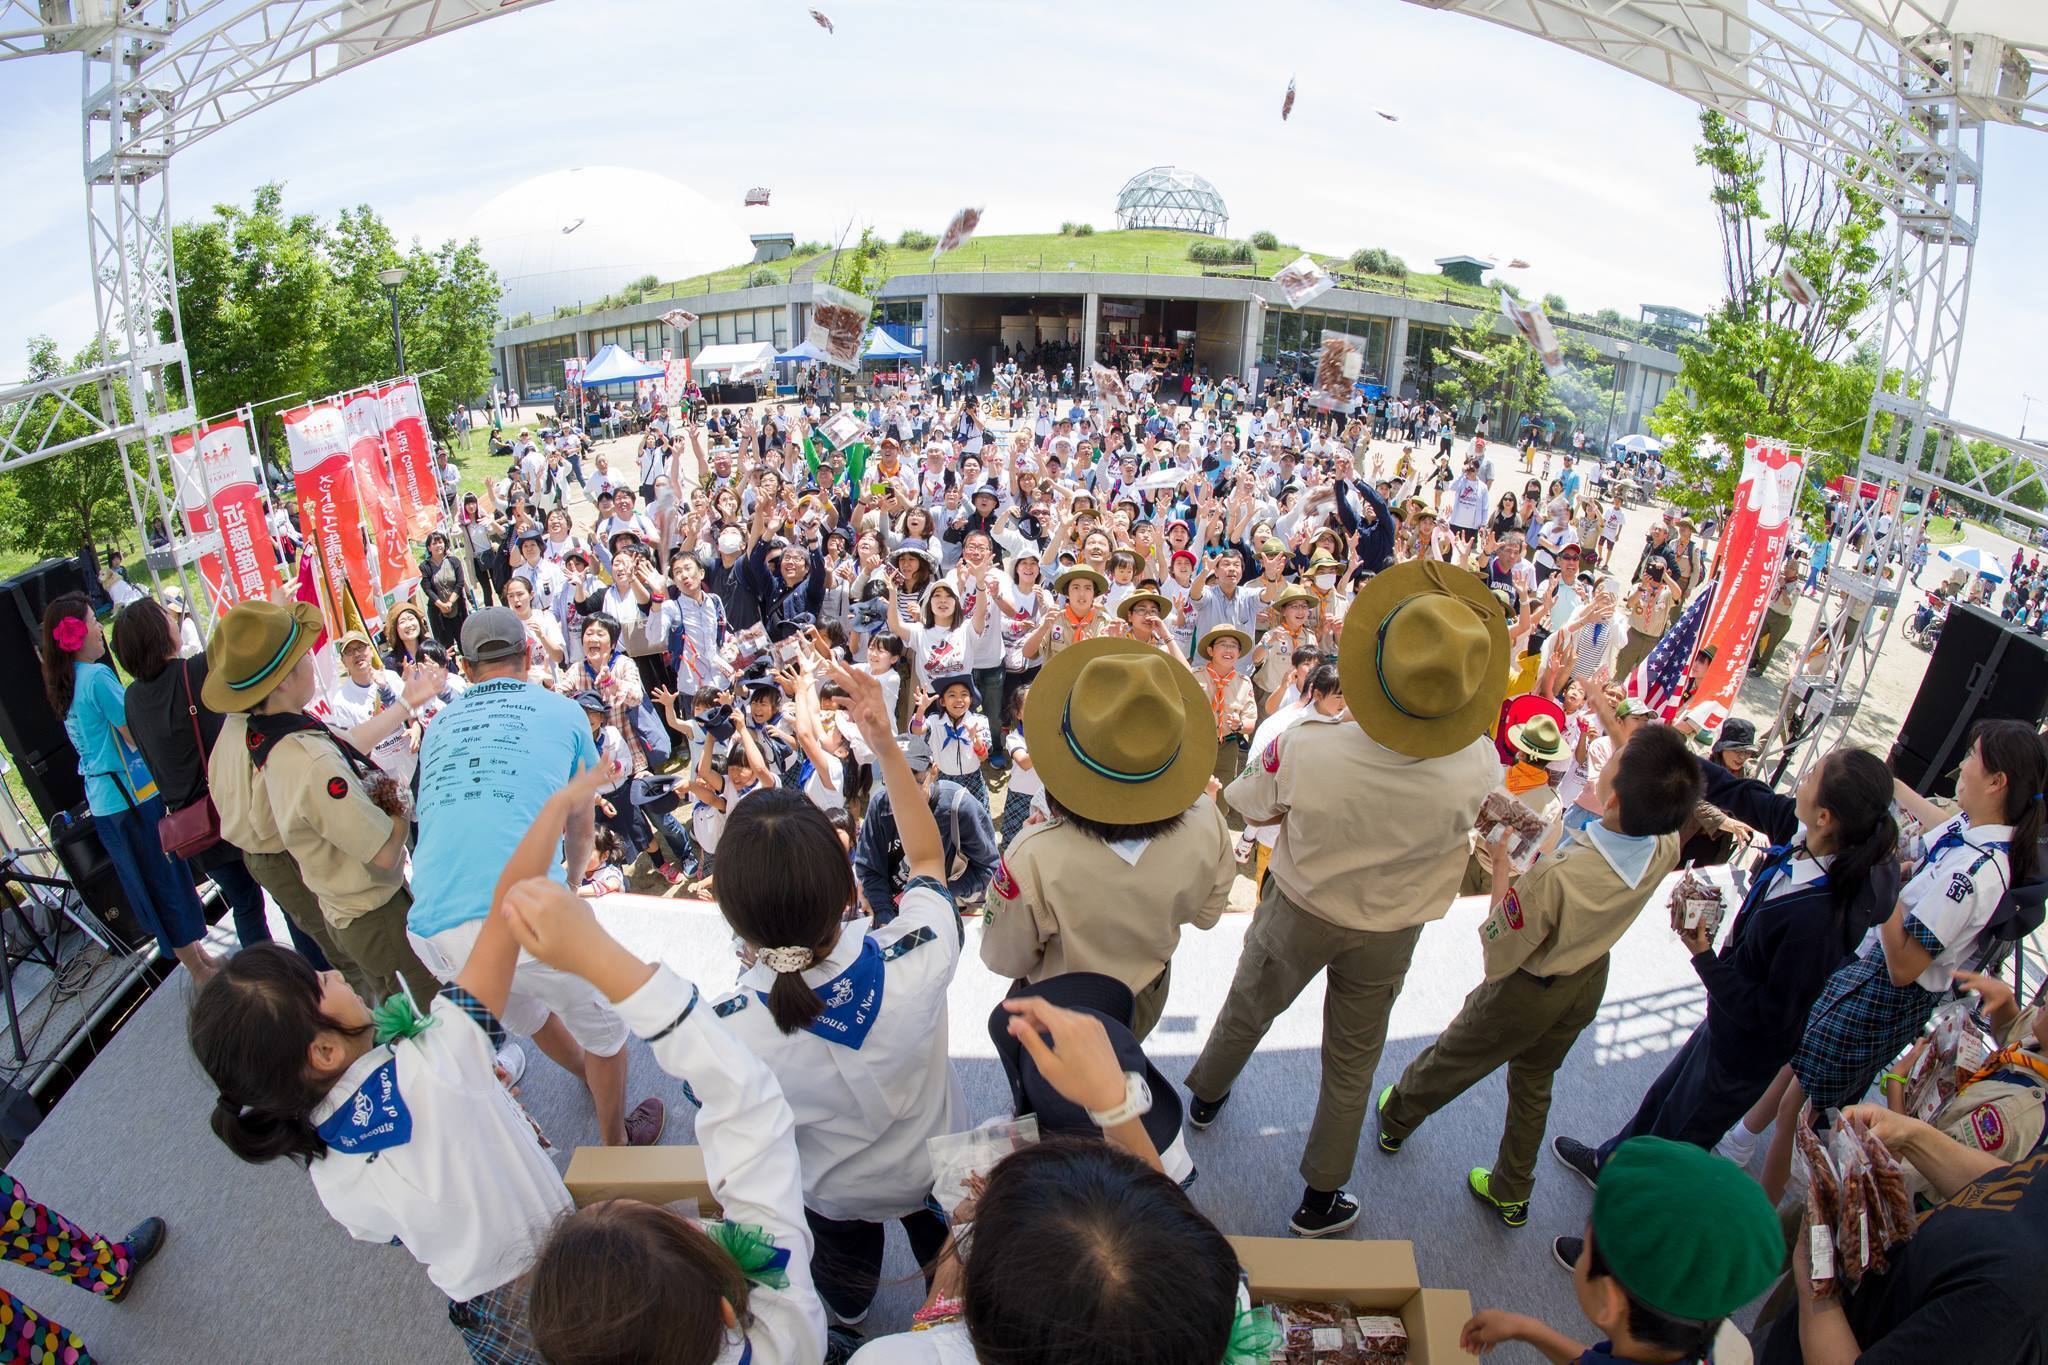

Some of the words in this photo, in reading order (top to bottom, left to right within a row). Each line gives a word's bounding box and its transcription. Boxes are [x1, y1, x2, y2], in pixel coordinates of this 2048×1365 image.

[464, 681, 527, 699] Volunteer
[500, 703, 537, 713] MetLife
[1948, 881, 1966, 900] 55
[1486, 920, 1500, 940] 35
[856, 1010, 866, 1025] of
[382, 1104, 398, 1117] of
